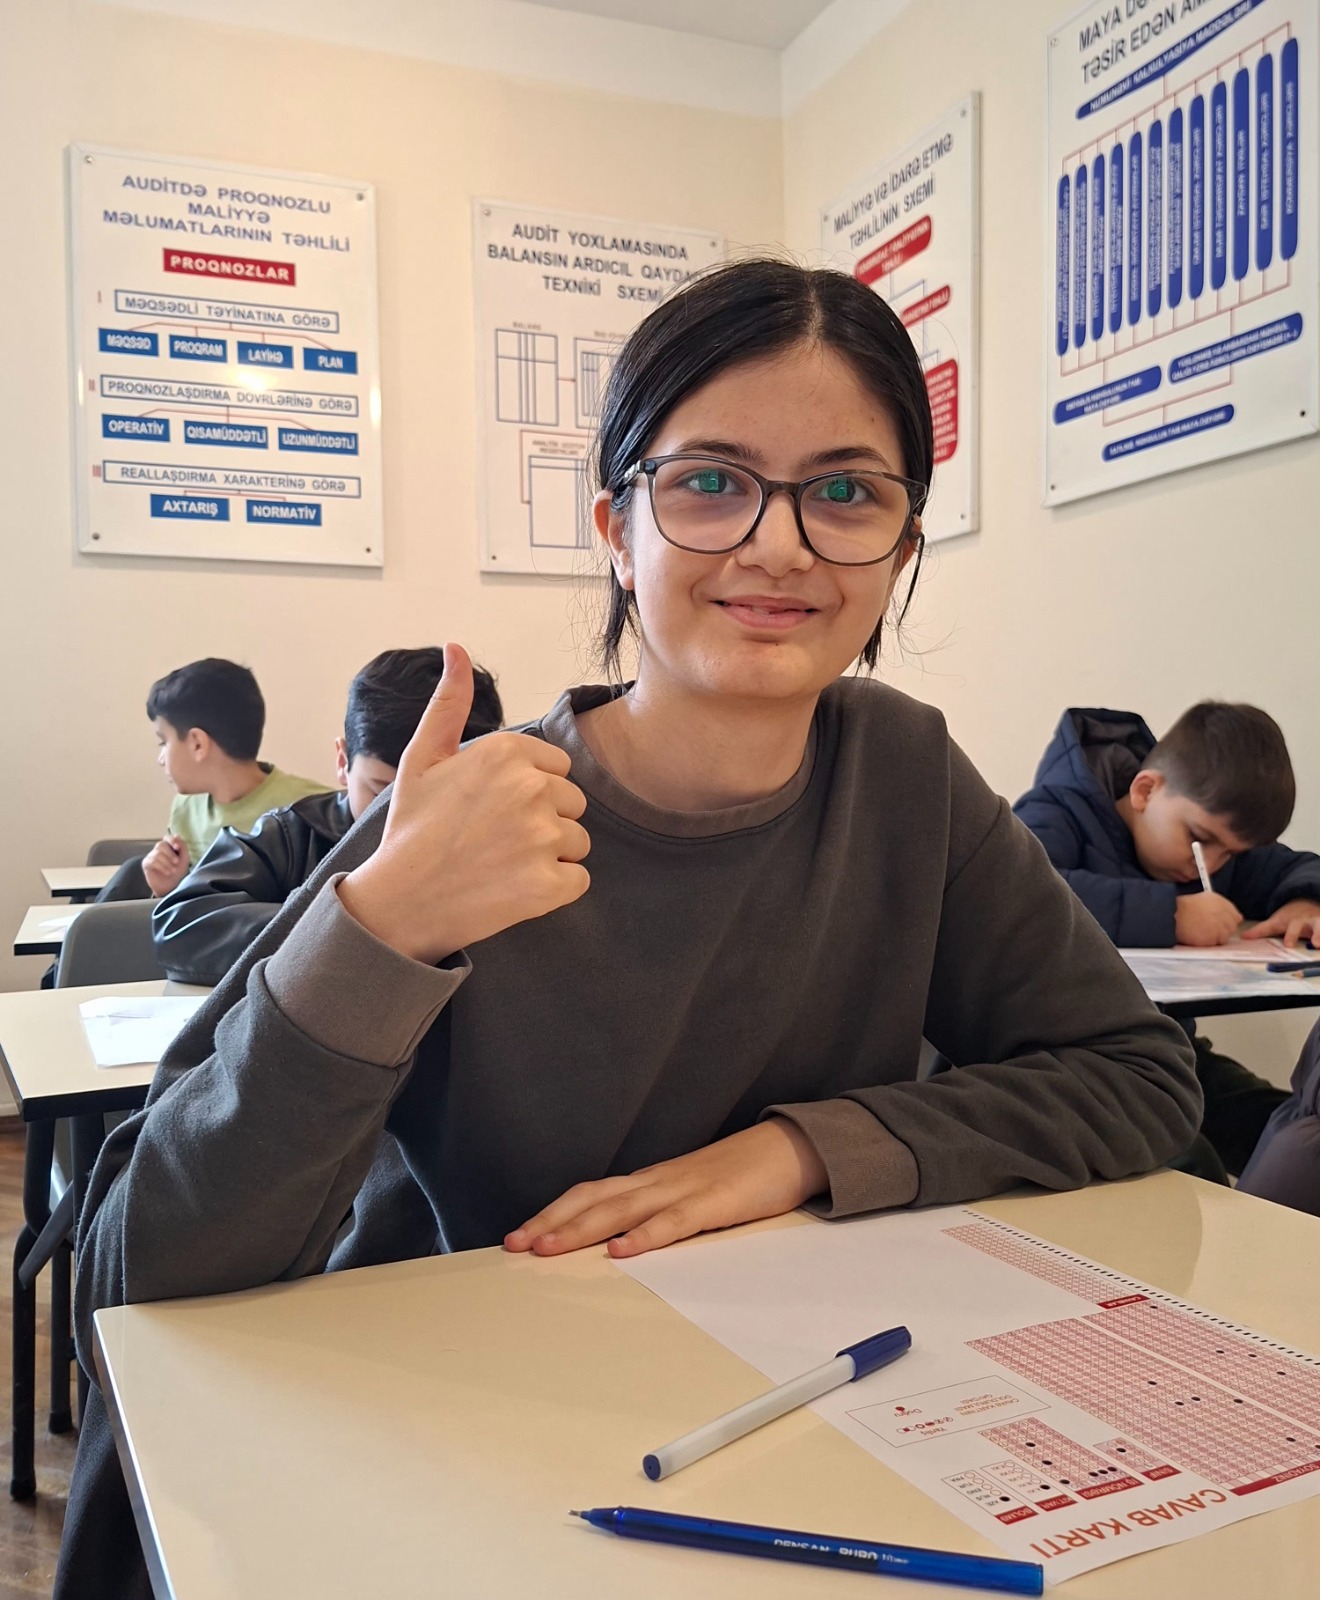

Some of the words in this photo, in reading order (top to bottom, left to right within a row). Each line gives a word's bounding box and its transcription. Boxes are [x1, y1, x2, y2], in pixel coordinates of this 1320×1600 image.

[1079, 6, 1121, 52] MAYA
[1082, 38, 1126, 84] TƏSİR
[1130, 7, 1174, 52] EDƏN
[122, 175, 207, 197] AUDİTDƏ
[218, 187, 331, 214] PROQNOZLU
[834, 193, 873, 234] MALİYYƏ
[874, 181, 888, 203] VƏ
[922, 133, 953, 169] ETMƏ
[188, 202, 270, 224] MALİYYƏ
[103, 210, 272, 243] MƏLUMATLARININ
[282, 231, 350, 252] TƏHLİLİ
[512, 223, 560, 243] AUDİT
[567, 231, 689, 261] YOXLAMASINDA
[170, 254, 289, 281] PROQNOZLAR
[487, 244, 568, 269] BALANSIN
[573, 258, 633, 278] ARDICIL
[542, 275, 601, 297] TEXNİKİ
[125, 296, 200, 315] MƏQSƏDLİ
[206, 306, 285, 324] TƏYİNATINA
[292, 313, 331, 328] GÖRƏ
[173, 338, 223, 357] PROQRAM
[248, 348, 283, 364] LAYİHƏ
[318, 355, 343, 369] PLAN
[108, 381, 231, 403] PROQNOZLAŞDIRMA
[319, 398, 352, 411] GÖRƏ
[108, 420, 164, 436] OPERATİV
[186, 426, 266, 444] QISAMÜDDƏTLİ
[282, 432, 356, 449] UZUNMÜDDƏTLİ
[120, 466, 216, 485] REALLAŞDIRMA
[223, 473, 306, 490] XARAKTERİNƏ
[312, 479, 346, 492] GÖRƏ
[162, 499, 218, 516] AXTARIŞ
[252, 505, 317, 520] NORMATİV
[1127, 1489, 1227, 1527] CAVAB
[1030, 1518, 1132, 1558] KARTI
